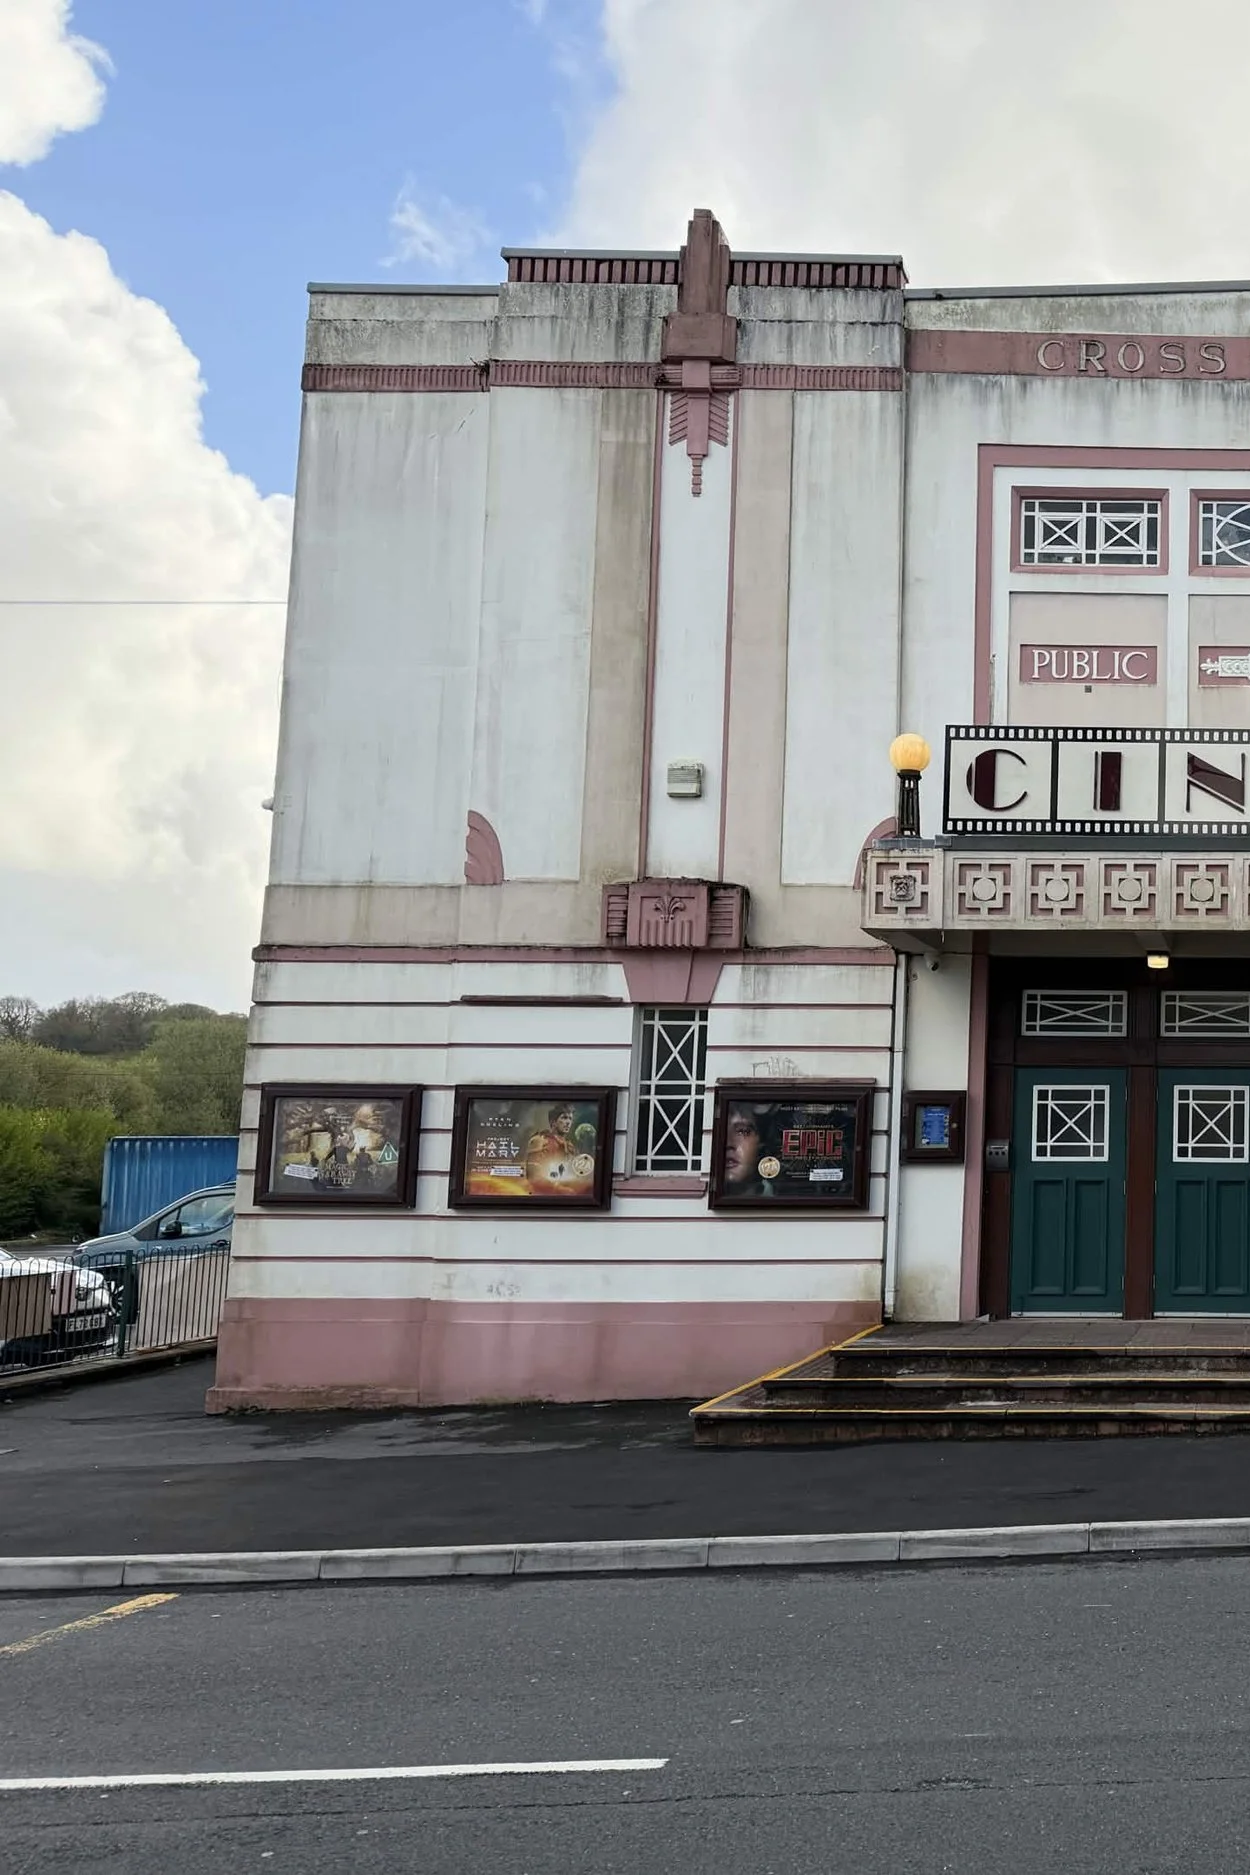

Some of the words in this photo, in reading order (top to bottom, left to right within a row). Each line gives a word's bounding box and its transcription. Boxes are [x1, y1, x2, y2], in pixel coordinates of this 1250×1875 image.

[1036, 339, 1227, 374] CROSS
[1031, 648, 1149, 681] PUBLIC
[476, 1140, 520, 1149] HAIL
[384, 1151, 392, 1161] U
[476, 1149, 519, 1158] MARY
